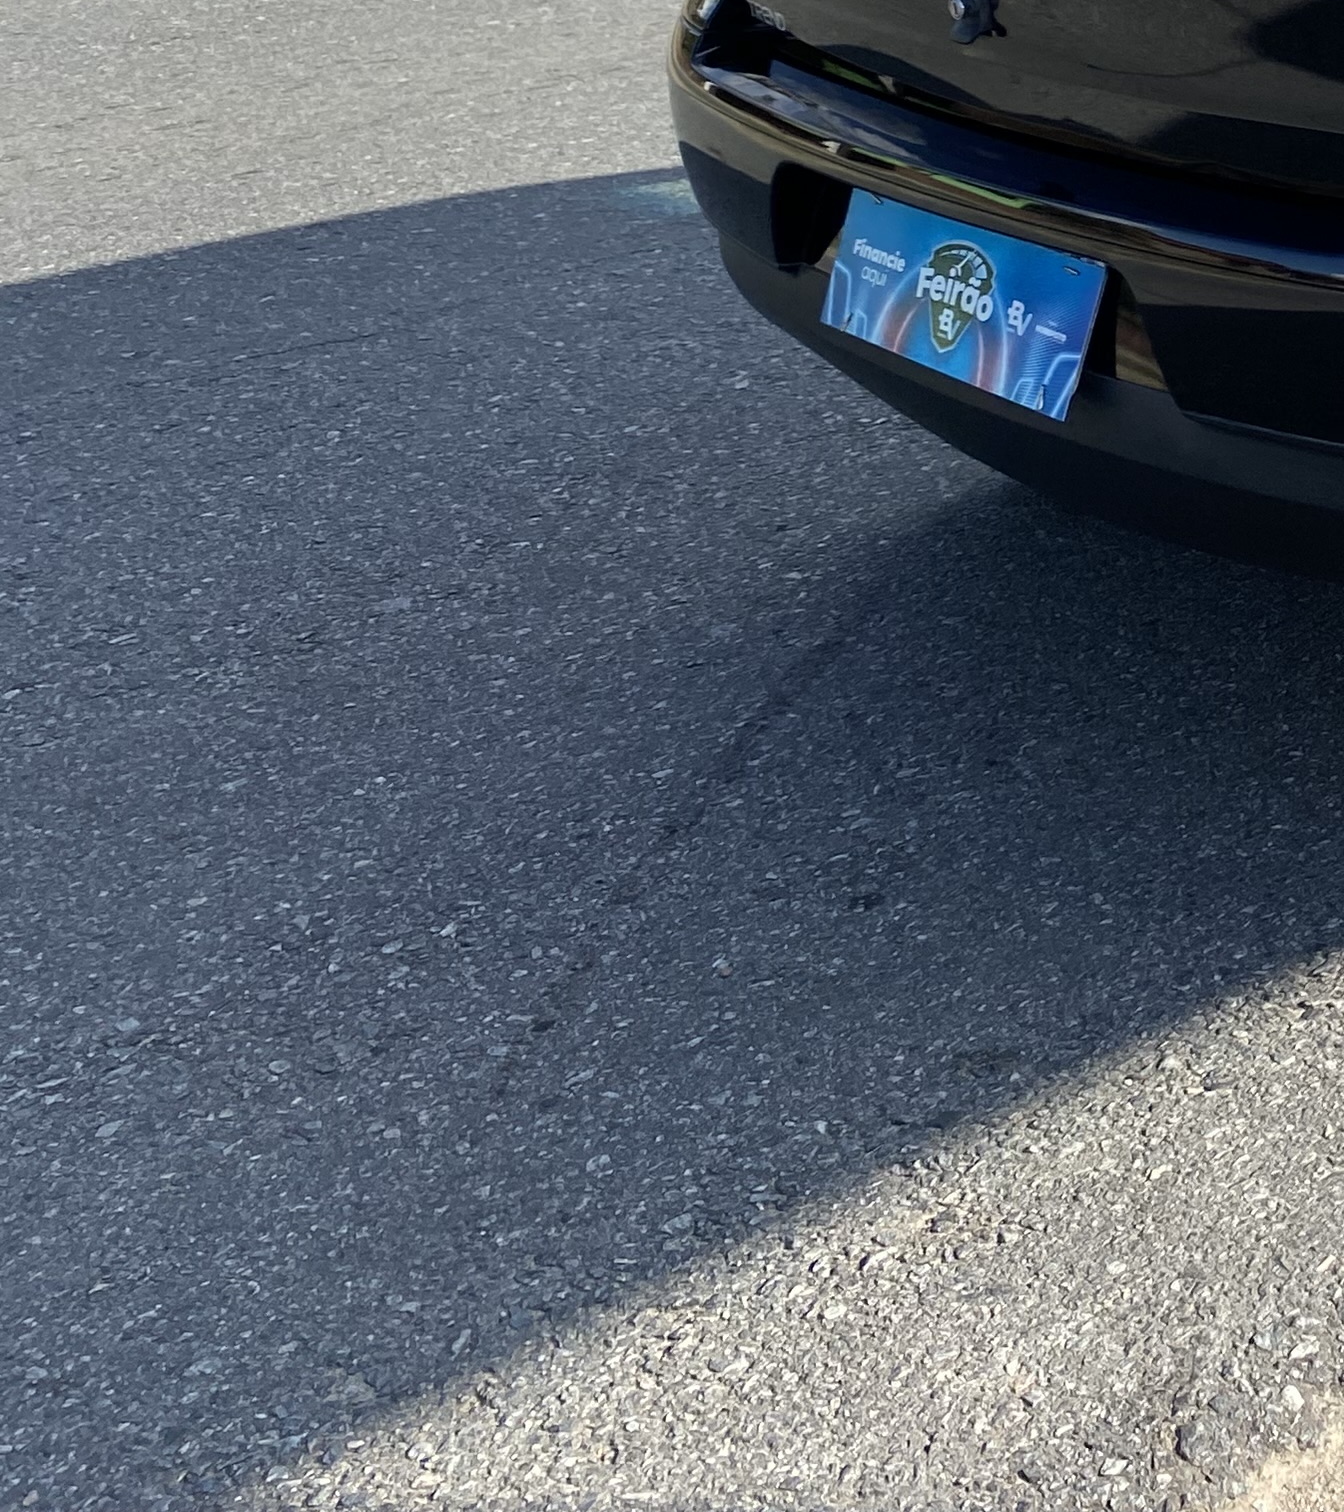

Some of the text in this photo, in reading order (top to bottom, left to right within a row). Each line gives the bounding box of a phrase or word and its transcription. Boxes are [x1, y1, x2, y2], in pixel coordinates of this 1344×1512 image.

[853, 238, 906, 272] Financie
[861, 266, 888, 287] aqui
[915, 267, 994, 322] Feirão
